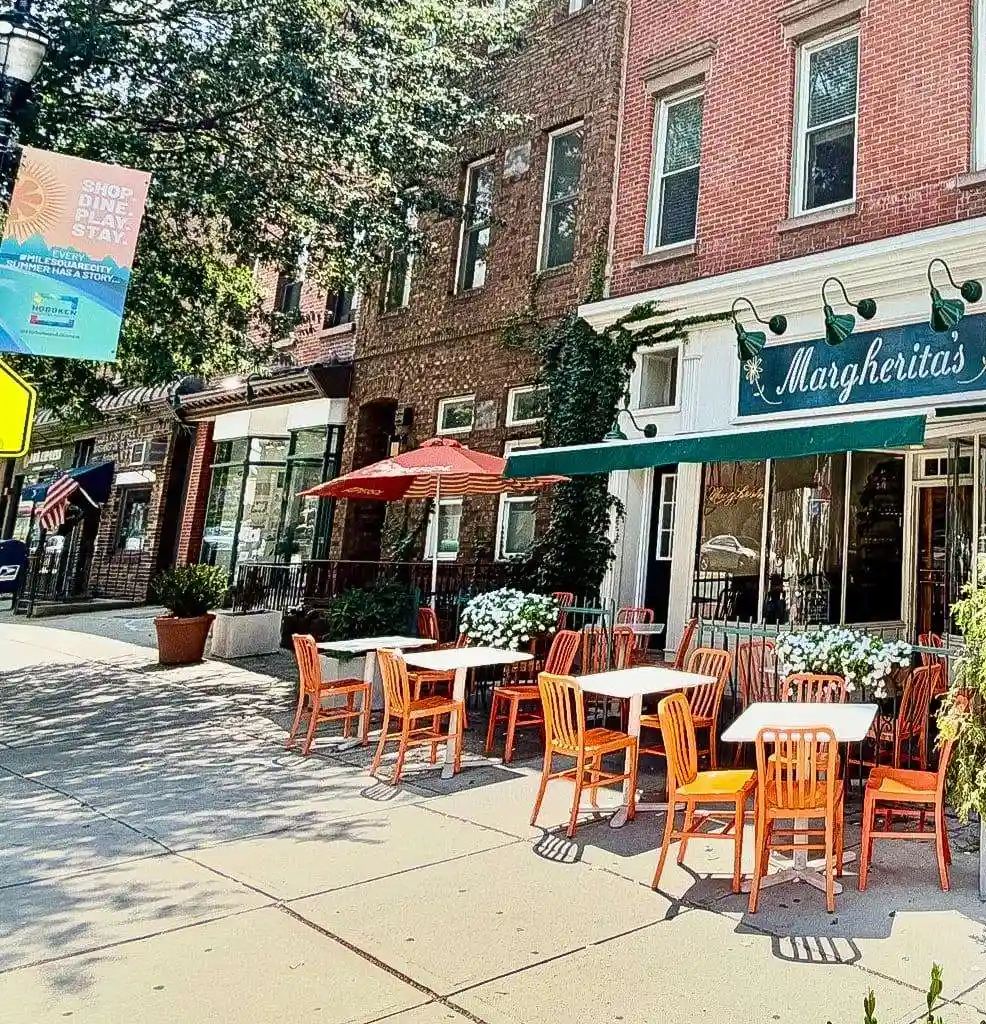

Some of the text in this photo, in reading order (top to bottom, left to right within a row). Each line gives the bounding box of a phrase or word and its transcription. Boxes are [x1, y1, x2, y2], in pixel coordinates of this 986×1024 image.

[79, 193, 133, 216] DINE.
[20, 253, 112, 274] #MILESQUARECITY
[52, 249, 86, 262] EVERY
[6, 259, 51, 274] SUMMER
[52, 267, 73, 278] HAS
[73, 270, 81, 278] A
[776, 330, 966, 404] Margherita's
